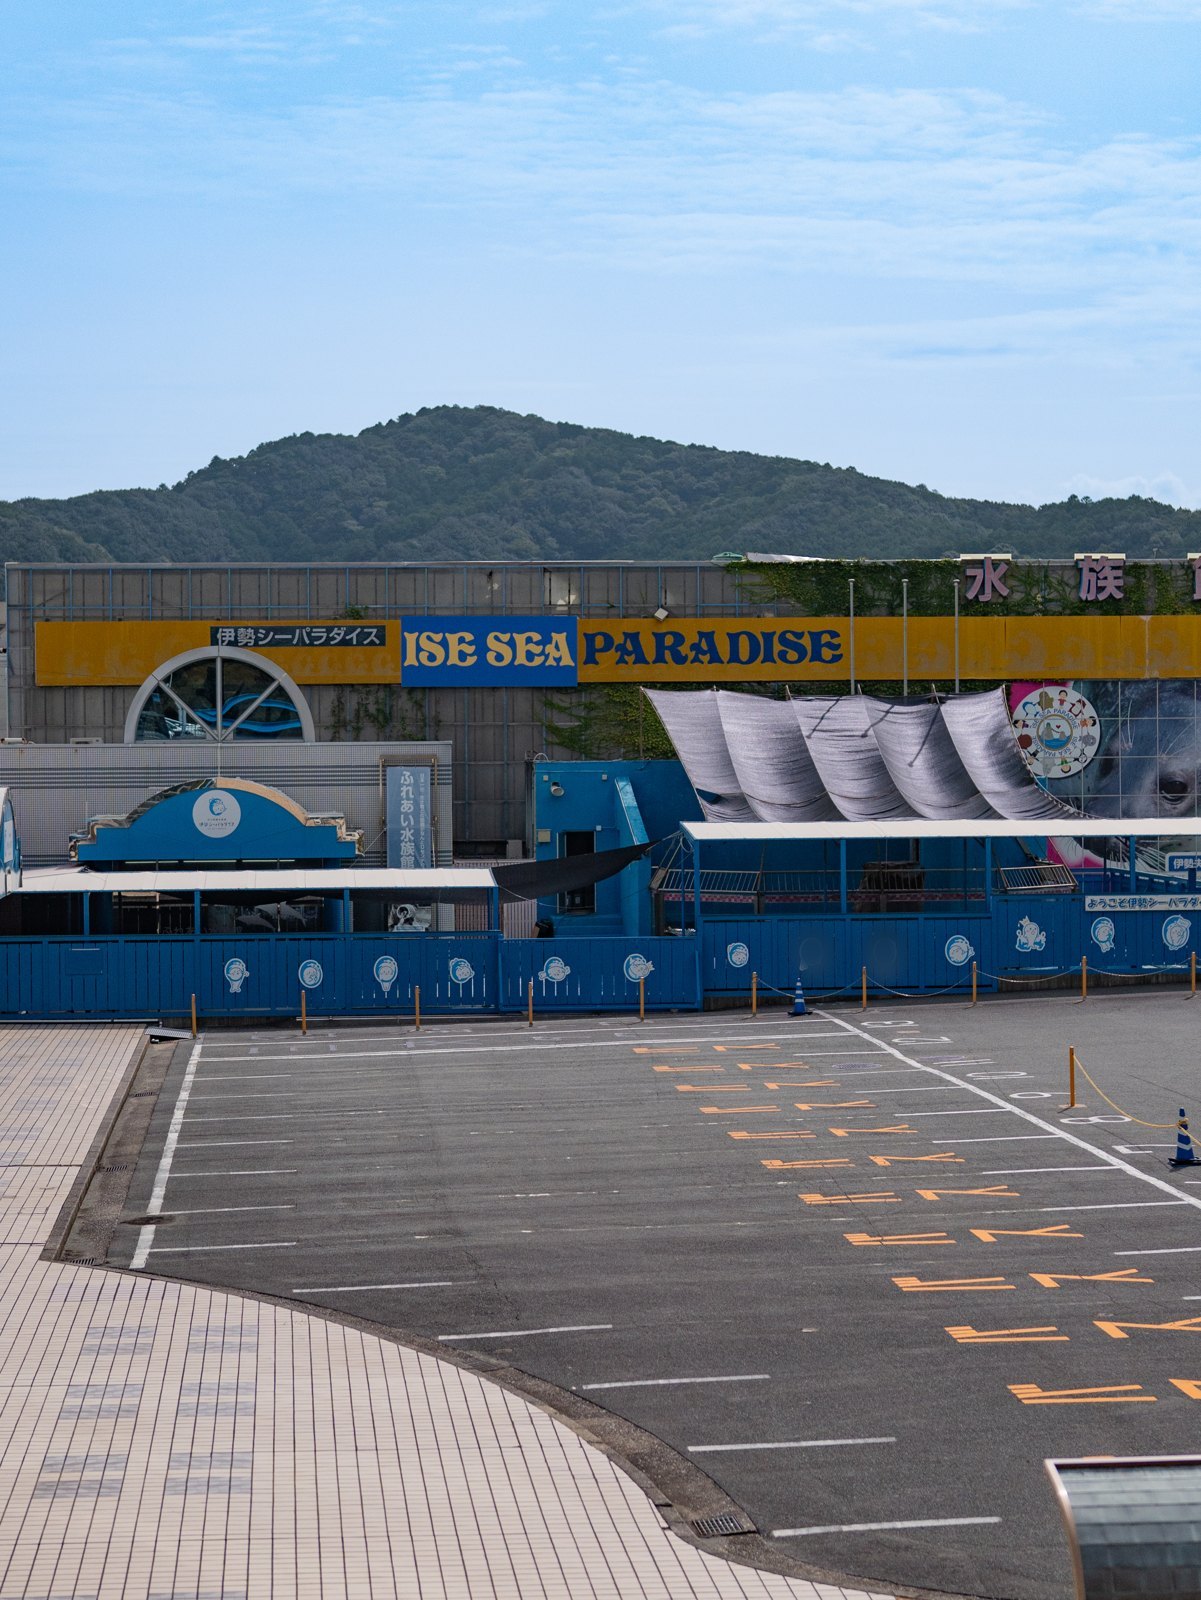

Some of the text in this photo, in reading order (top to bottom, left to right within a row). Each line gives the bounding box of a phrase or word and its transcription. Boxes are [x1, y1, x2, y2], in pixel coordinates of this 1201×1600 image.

[966, 556, 1201, 602] 水族
[217, 627, 381, 646] 伊勢シーパラダイス
[403, 630, 844, 667] ISE SEA PARADISE
[400, 771, 415, 869] ふれあい水族館
[1087, 897, 1201, 909] ようこそ伊勢シーパラダ
[860, 1020, 919, 1028] 13
[892, 1036, 953, 1045] 12
[966, 1071, 1035, 1080] 10
[1060, 1115, 1133, 1124] 8
[1112, 1144, 1195, 1154] 7
